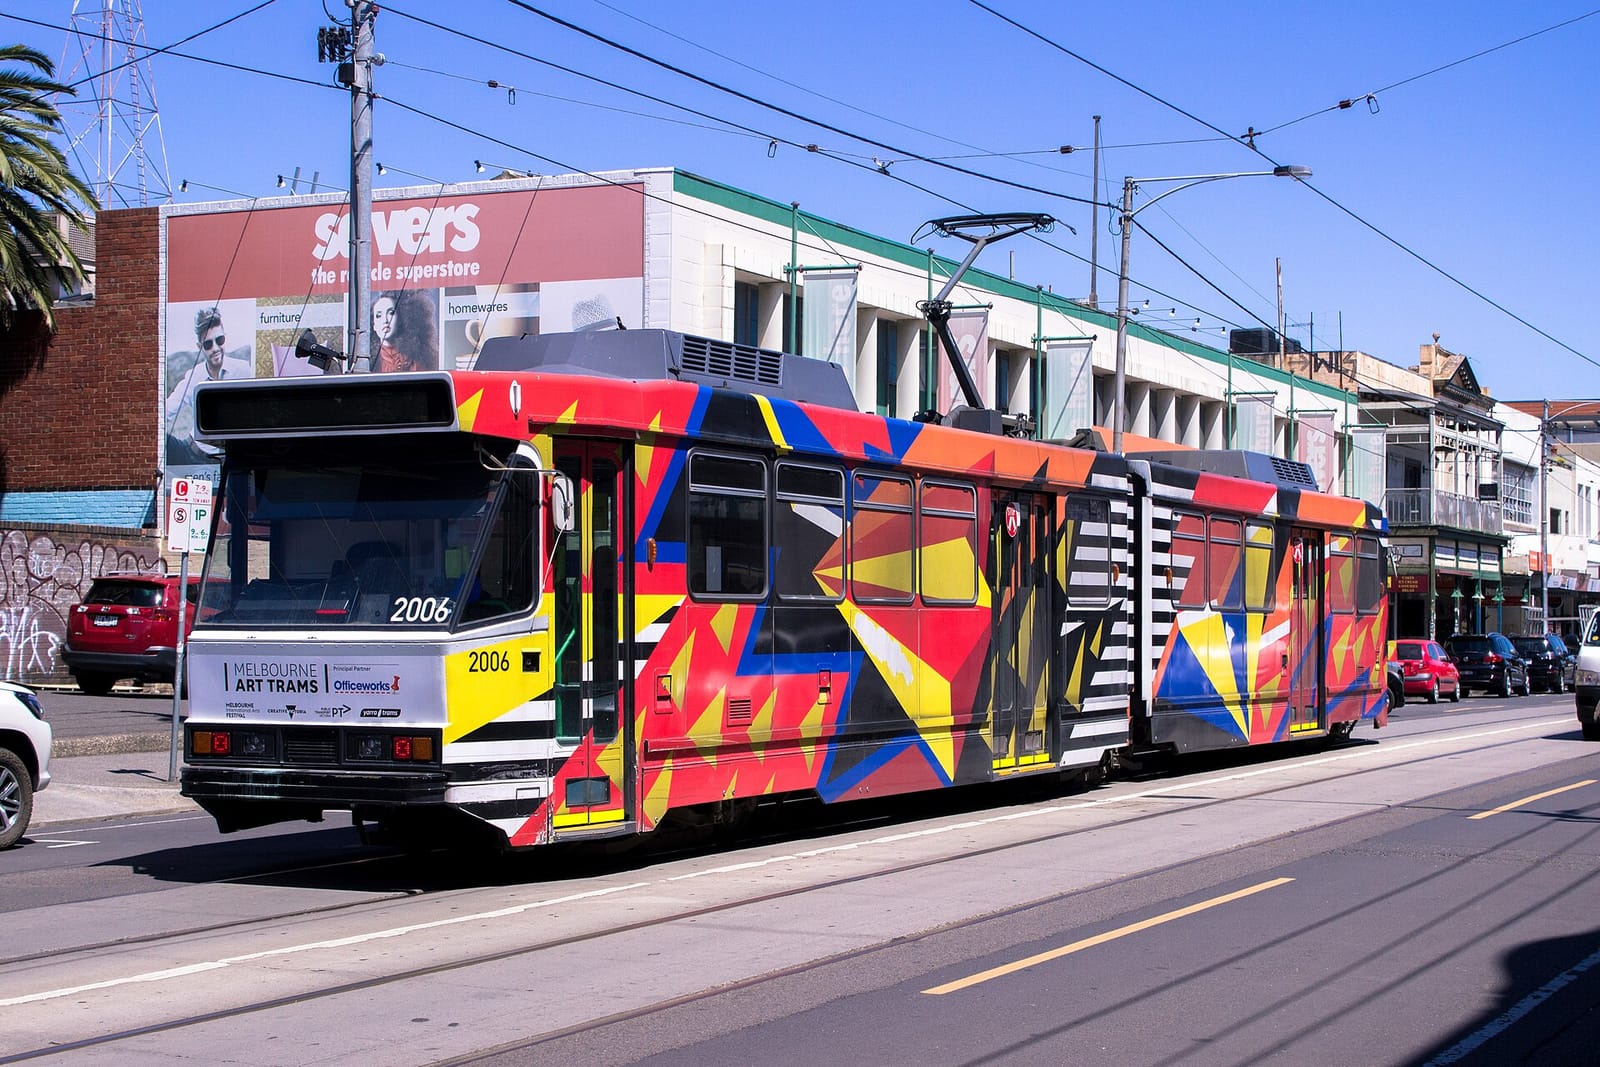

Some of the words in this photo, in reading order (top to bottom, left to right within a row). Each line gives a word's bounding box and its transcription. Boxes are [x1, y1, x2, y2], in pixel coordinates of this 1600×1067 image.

[311, 265, 336, 284] the
[396, 260, 480, 283] superstore
[448, 301, 508, 315] homewares
[259, 312, 301, 324] furniture
[176, 510, 184, 521] S
[194, 509, 207, 521] 1P
[390, 597, 450, 622] 2006
[468, 651, 510, 673] 2006
[234, 662, 318, 678] MELBOURNE
[235, 679, 264, 692] ART
[267, 679, 319, 693] TRAMS
[333, 680, 391, 691] Officeworks
